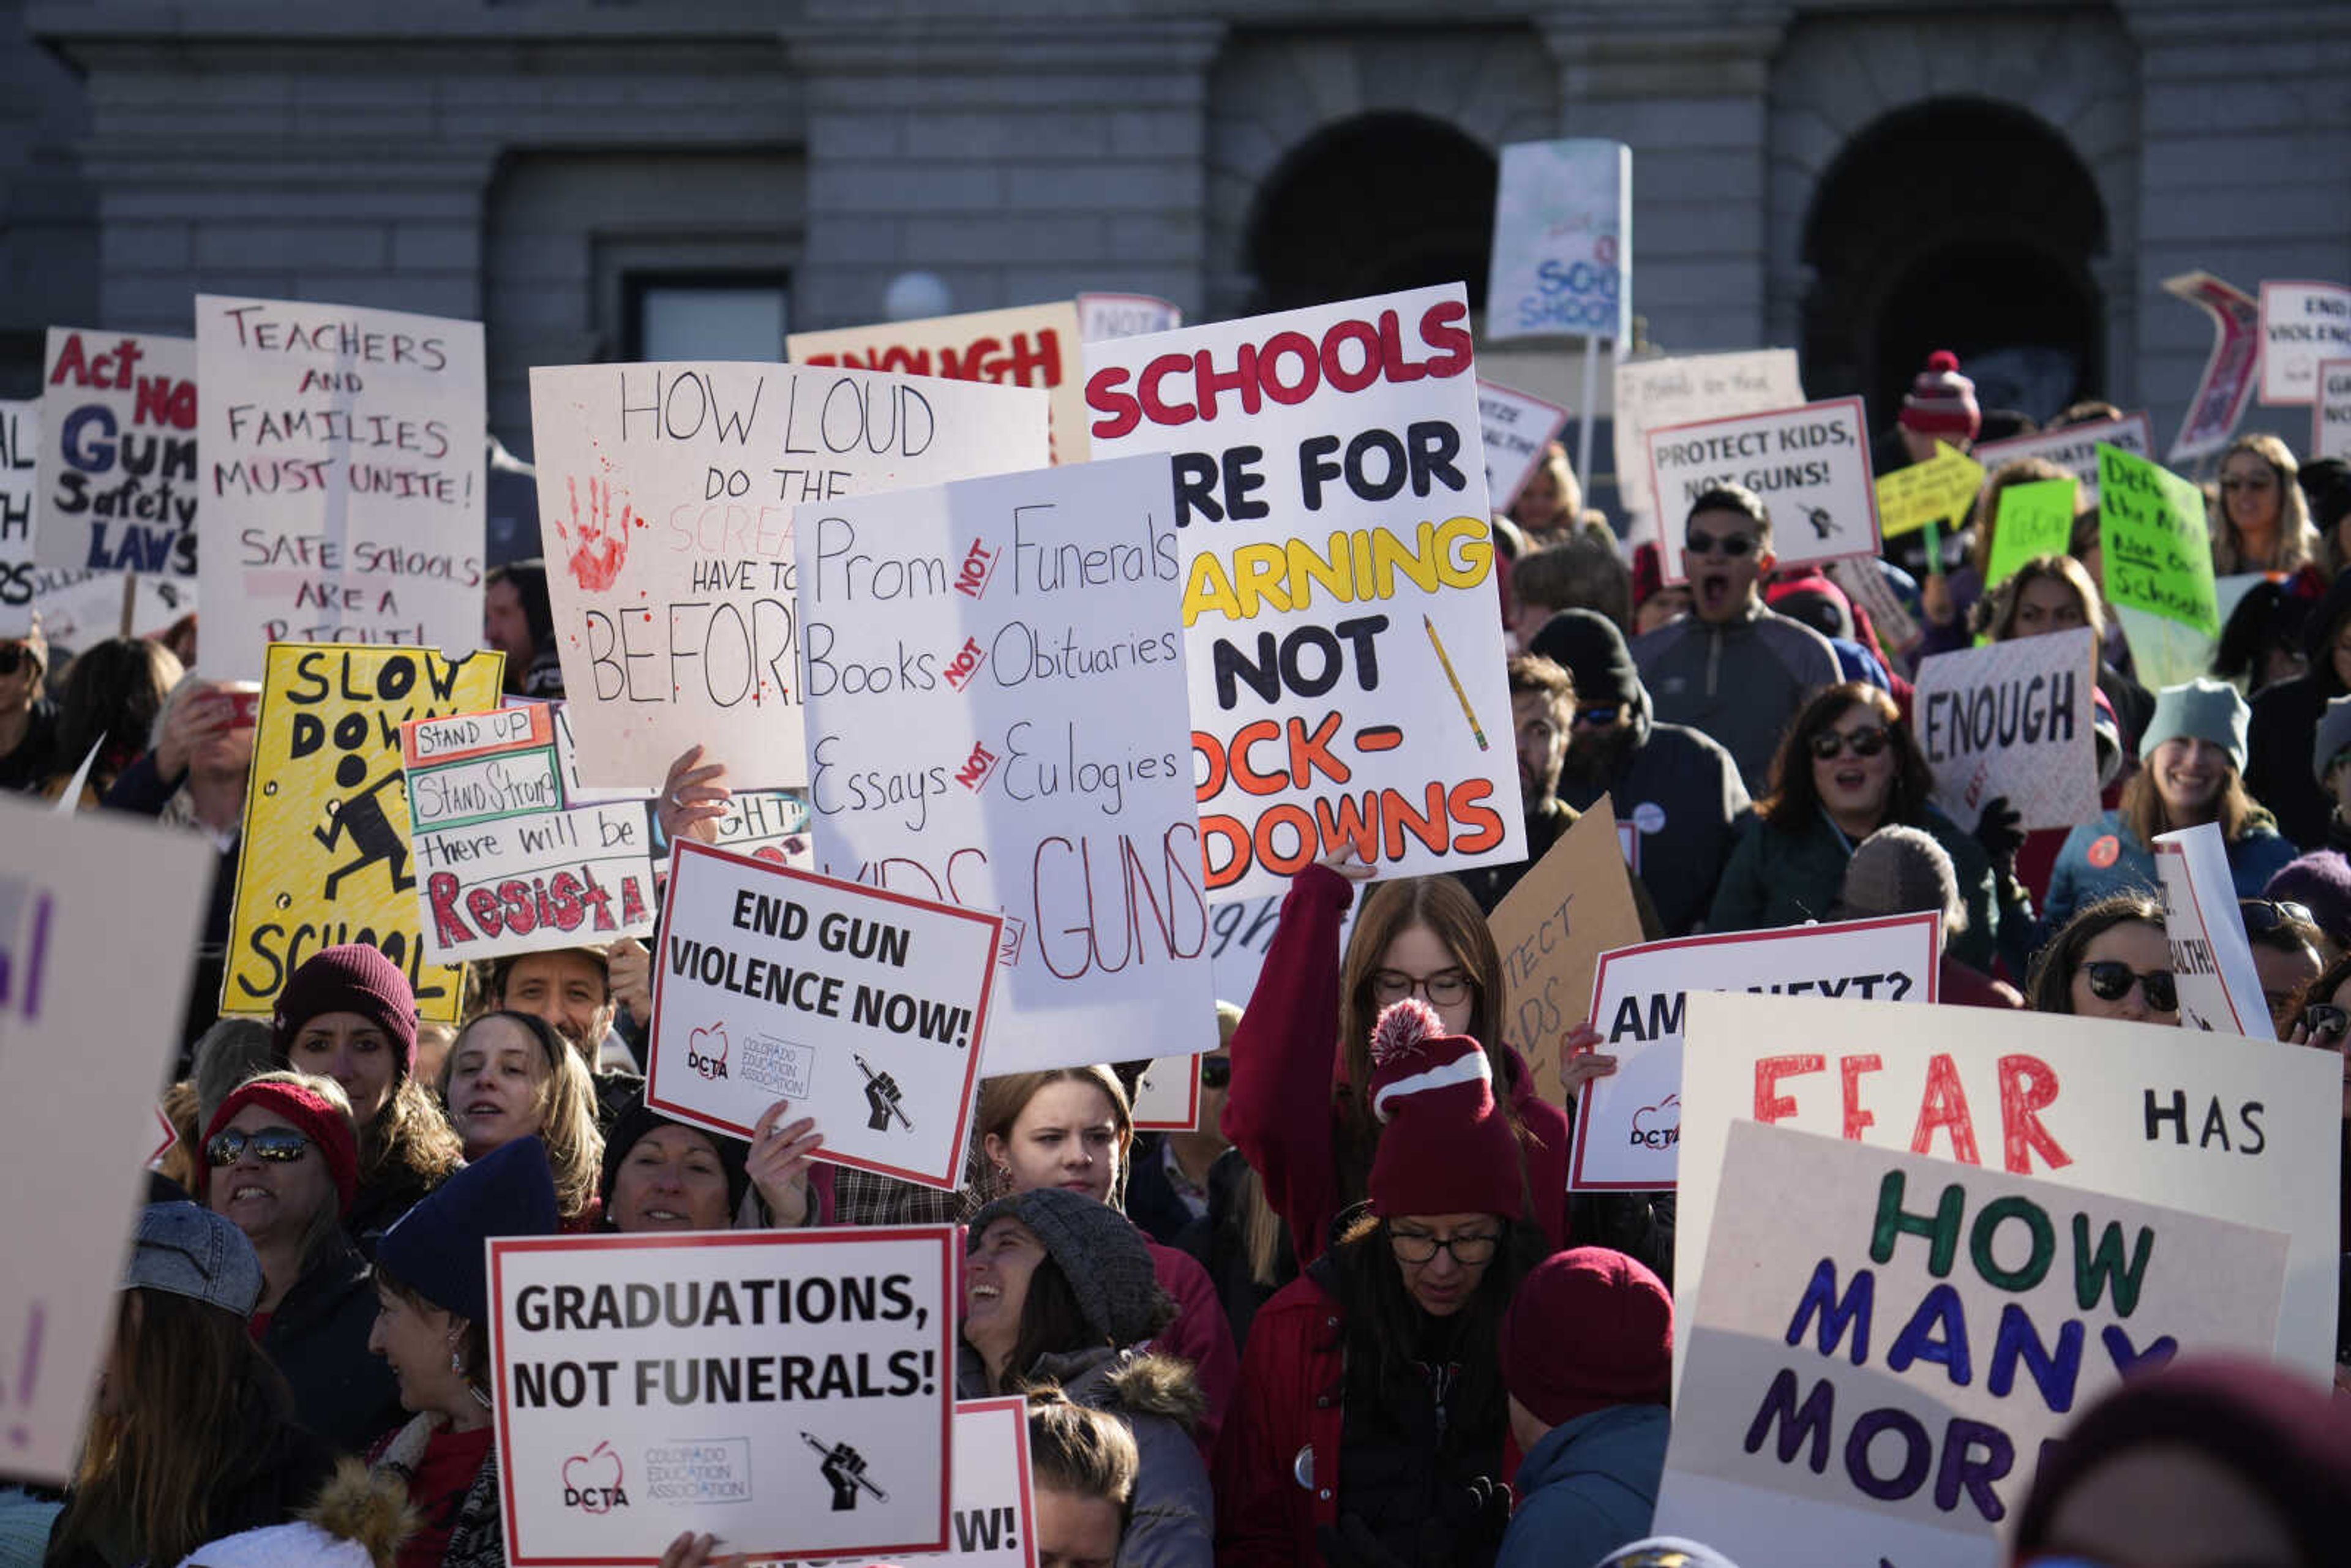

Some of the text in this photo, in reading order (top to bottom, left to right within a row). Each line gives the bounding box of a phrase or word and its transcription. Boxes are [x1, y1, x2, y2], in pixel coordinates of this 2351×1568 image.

[49, 334, 144, 390] Act
[224, 305, 447, 372] TEACHERS
[804, 327, 1062, 388] OUGH
[299, 369, 363, 394] AND
[1084, 301, 1473, 439] SCHOOLS
[0, 409, 34, 470] L
[228, 406, 449, 459] FAMILIES
[620, 370, 934, 457] HOW LOUD
[1655, 420, 1855, 469] PROTECT KIDS,
[53, 470, 197, 533] Safety
[214, 459, 474, 509] MUST UNITE!
[705, 467, 852, 502] DO THE
[1172, 421, 1467, 528] RE FOR
[1744, 460, 1831, 492] GUNS!
[87, 522, 197, 577] LAWS
[240, 529, 482, 588] SAFE SCHOOLS
[692, 559, 757, 593] HAVE
[817, 504, 1180, 602] Prom NOT Funerals
[1182, 516, 1493, 628] ARNING
[294, 581, 398, 615] ARE A
[285, 650, 460, 705] SLOW
[586, 598, 804, 708] BEFOR
[806, 621, 1179, 697] Books NOT Obituaries
[1213, 614, 1390, 710] NOT
[290, 707, 457, 760] DOW
[492, 712, 528, 742] UP
[1926, 670, 2075, 763] ENOUGH
[813, 721, 1177, 831] Essays NOT Eulogies
[418, 811, 635, 868] there will be
[1199, 778, 1505, 890] DOWNS
[733, 889, 911, 968] END GUN
[1034, 822, 1207, 980] GUNS
[237, 922, 446, 999] SCOL
[1503, 893, 1575, 989] TECT
[671, 936, 973, 1049] VIOLENCE NOW!
[1608, 993, 1685, 1044] AM
[688, 1051, 729, 1079] DCTA
[741, 1052, 798, 1078] EDUCATION
[743, 1036, 796, 1062] COLORADO
[740, 1068, 803, 1094] ASSOCIATION
[1753, 1053, 2267, 1176] FEAR HAS
[1869, 1169, 2154, 1318] HOW
[516, 1274, 928, 1332] GRADUATIONS,
[513, 1350, 936, 1408] NOT FUNERALS!
[646, 1447, 727, 1463] COLORADO
[646, 1465, 731, 1482] EDUCATION
[1744, 1368, 2071, 1523] MOR
[563, 1487, 630, 1507] DCTA
[646, 1482, 745, 1499] ASSOCIATION
